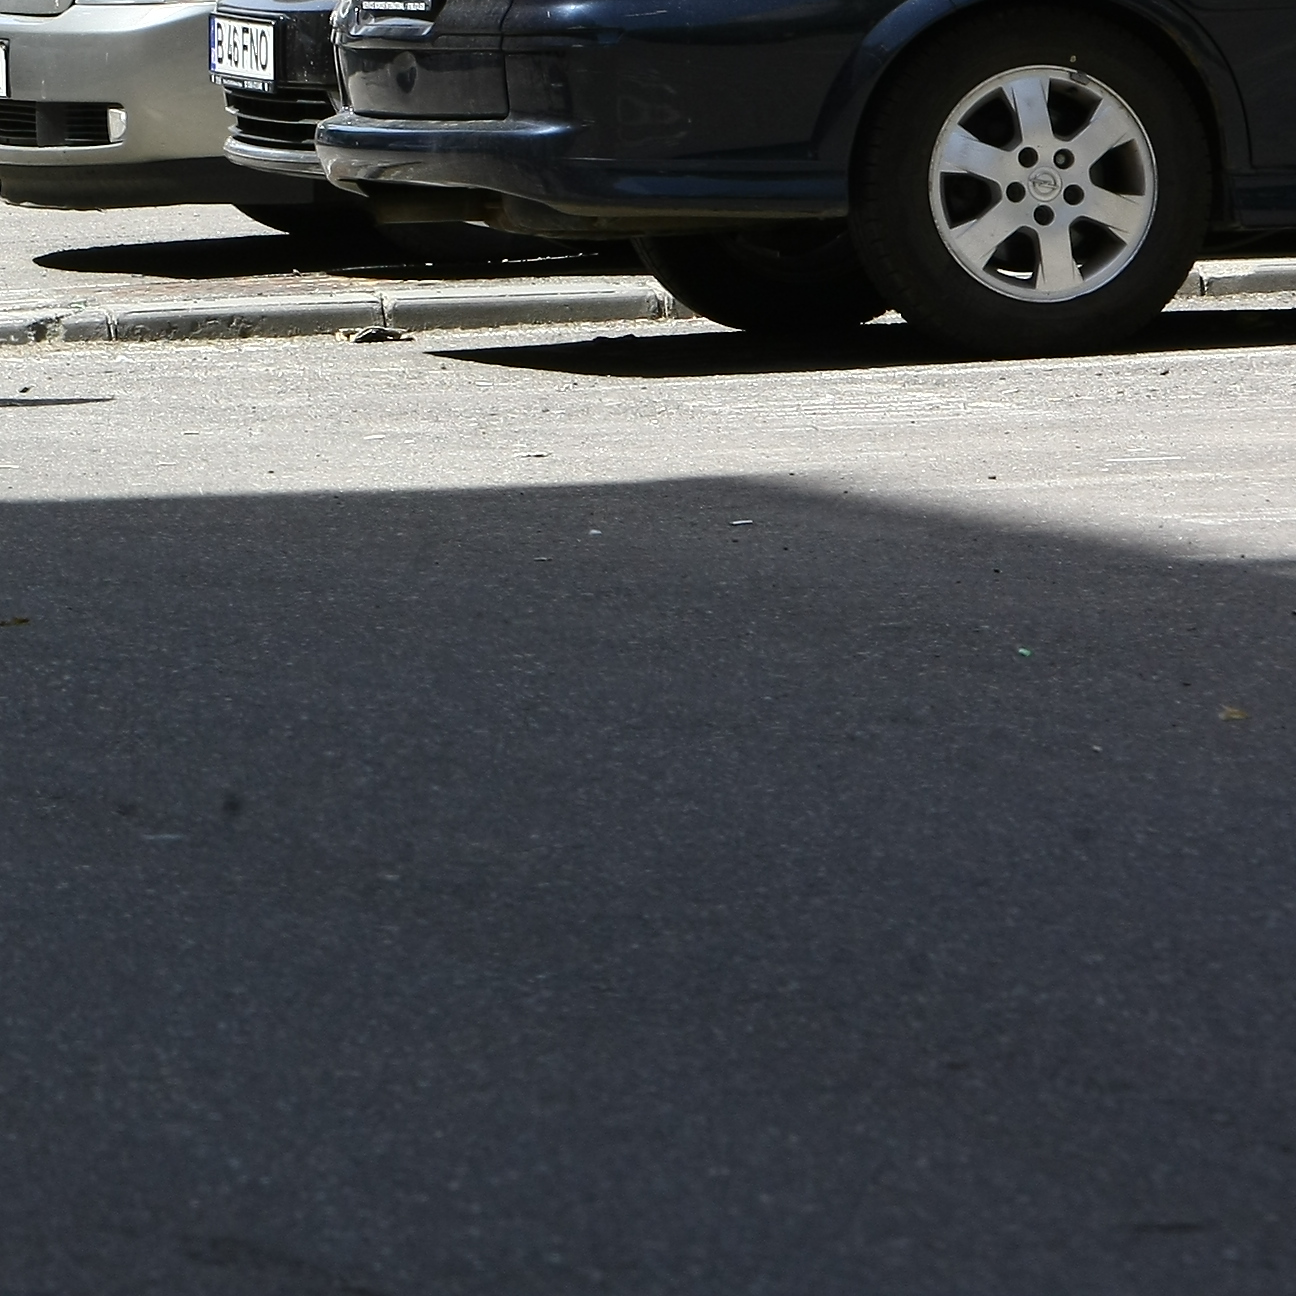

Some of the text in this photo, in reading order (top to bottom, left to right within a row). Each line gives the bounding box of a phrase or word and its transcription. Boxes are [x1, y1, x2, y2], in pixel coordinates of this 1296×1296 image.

[216, 22, 269, 72] B 46 FNO
